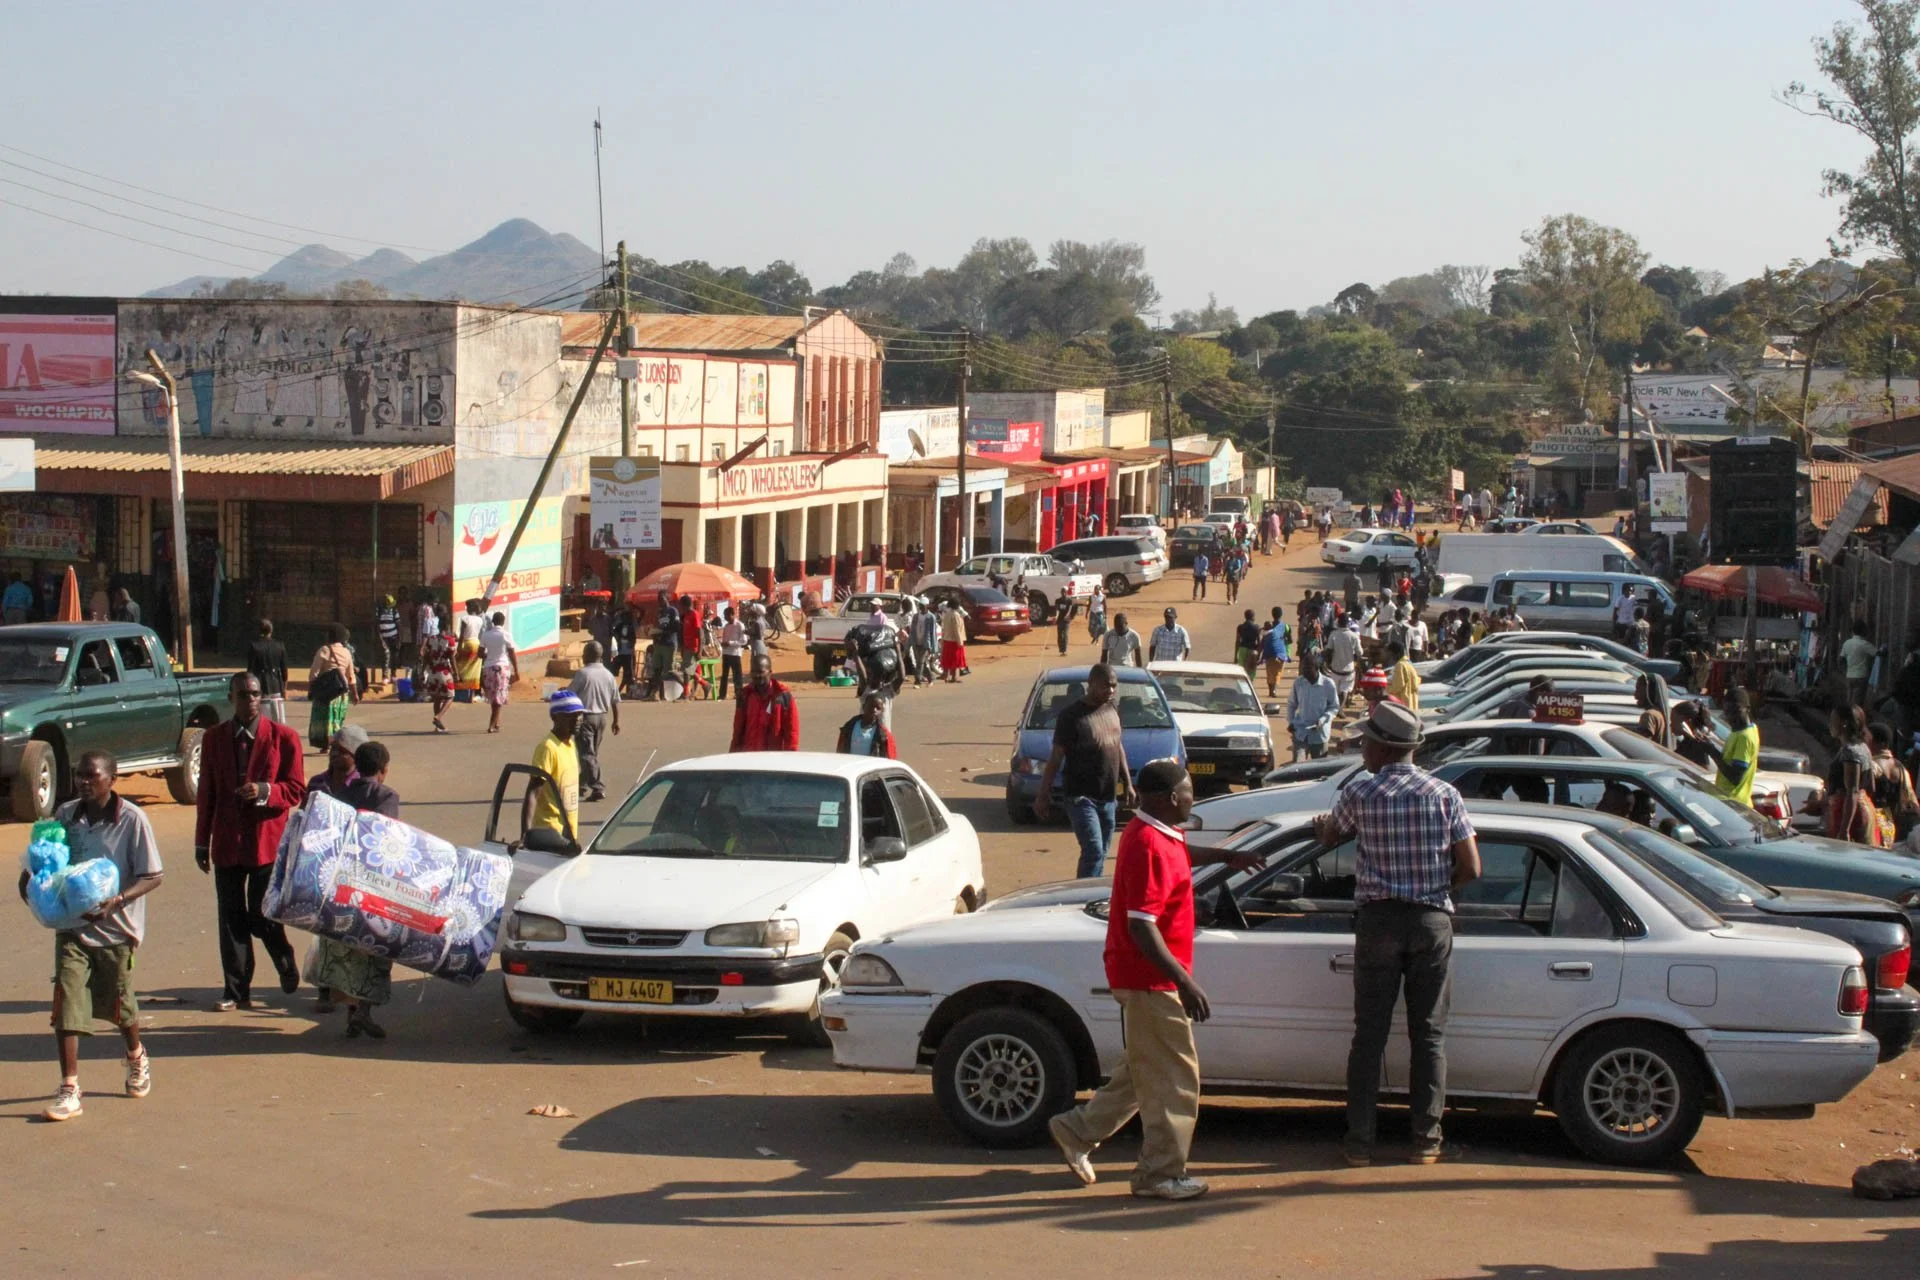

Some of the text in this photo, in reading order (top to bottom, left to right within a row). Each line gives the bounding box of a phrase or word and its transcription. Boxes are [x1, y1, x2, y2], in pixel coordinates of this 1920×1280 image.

[667, 365, 683, 385] DEN
[1656, 386, 1673, 396] PAT
[15, 404, 115, 420] WOCHAPIRA
[1564, 426, 1601, 436] KAKA
[751, 463, 817, 494] WHOLESALERS
[510, 571, 541, 592] Soap
[365, 872, 428, 901] Flexa Foam
